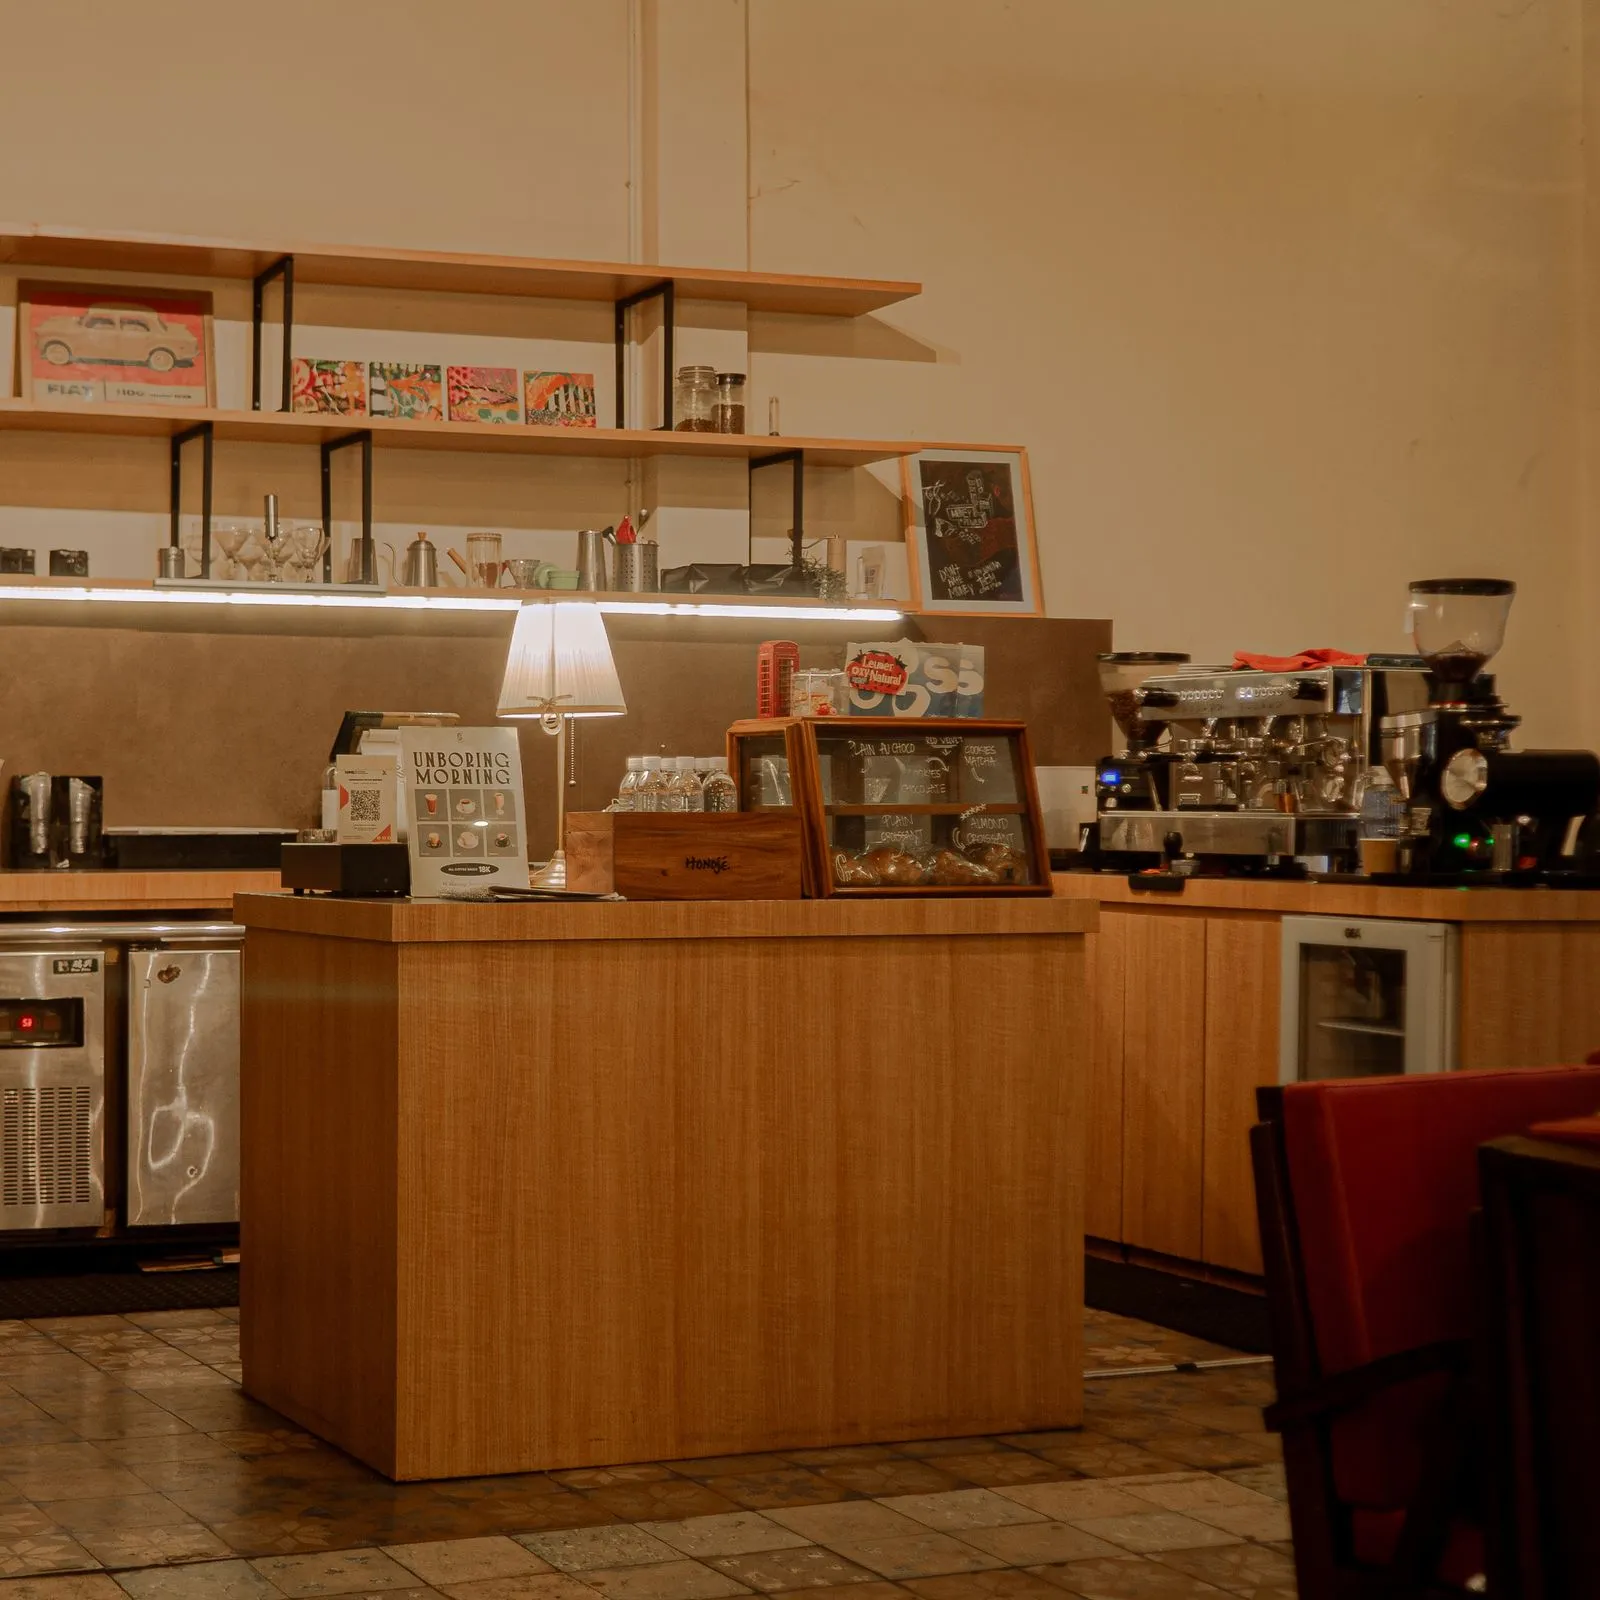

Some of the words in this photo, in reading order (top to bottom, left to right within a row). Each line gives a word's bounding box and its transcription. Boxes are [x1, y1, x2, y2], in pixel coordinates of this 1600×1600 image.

[869, 670, 902, 686] Natural
[964, 745, 996, 755] COOKIES
[413, 752, 510, 768] UNBORING
[964, 756, 996, 768] MATCHA
[416, 769, 510, 785] MORNING
[881, 815, 914, 828] PLAIN
[971, 818, 1009, 830] ALMOND
